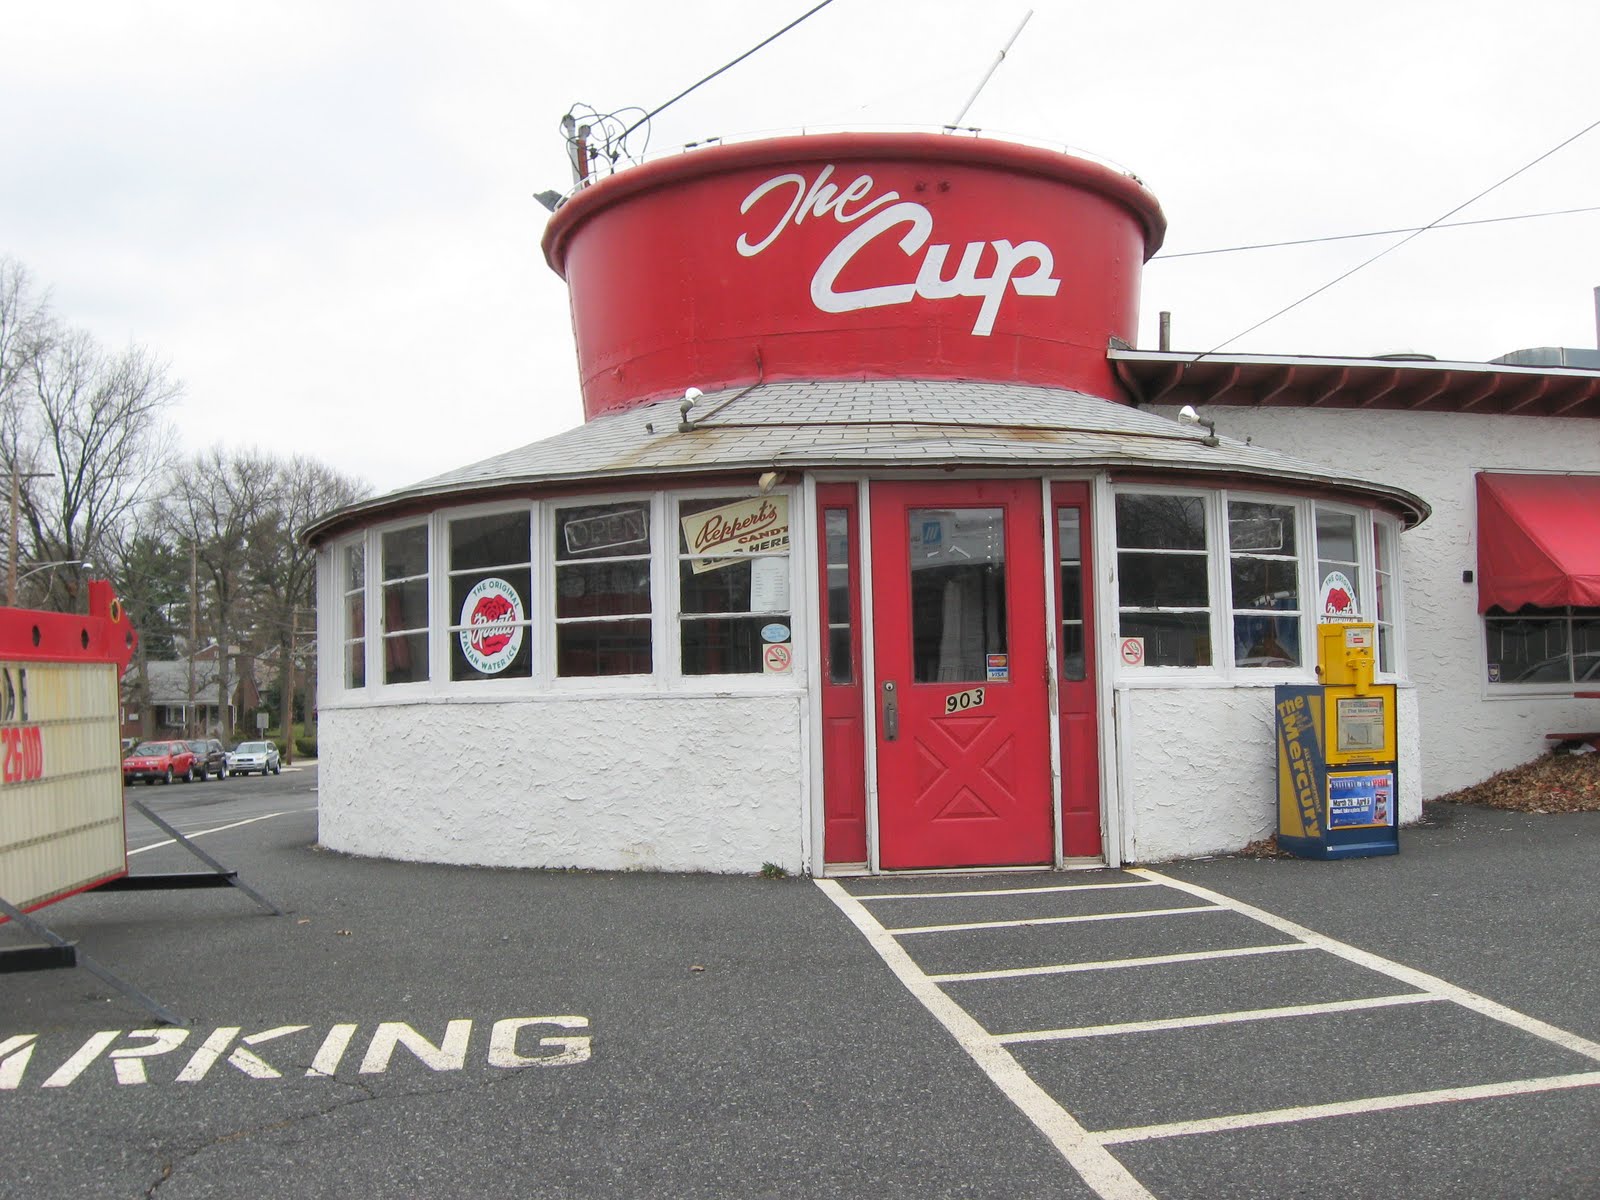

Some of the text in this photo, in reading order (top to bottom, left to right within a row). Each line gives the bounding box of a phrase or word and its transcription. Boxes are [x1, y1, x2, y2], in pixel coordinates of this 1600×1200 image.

[736, 164, 900, 257] The
[810, 201, 1062, 336] Cup
[695, 500, 777, 549] Reppert's
[749, 535, 790, 552] HERE
[473, 581, 519, 608] THE ORIGINAL
[461, 631, 518, 671] ITALIAN WATER ICE
[946, 689, 984, 712] 903
[1277, 695, 1304, 717] The
[1282, 713, 1321, 837] Mercury
